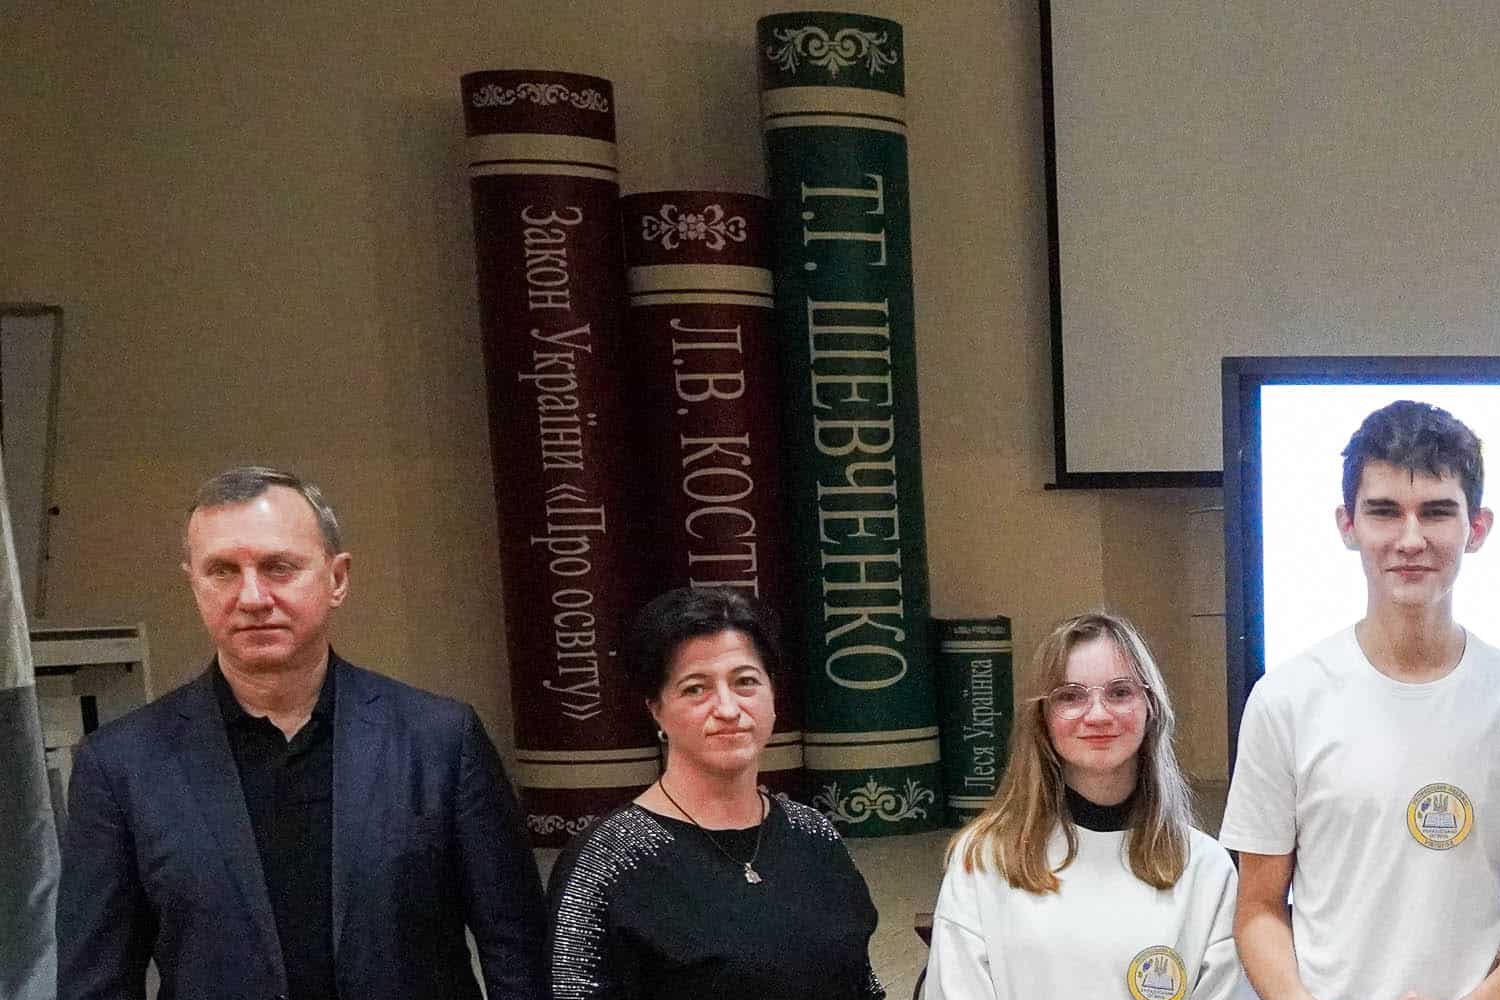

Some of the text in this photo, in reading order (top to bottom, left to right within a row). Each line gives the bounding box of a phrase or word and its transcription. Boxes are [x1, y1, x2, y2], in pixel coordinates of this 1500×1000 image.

[518, 205, 616, 721] Закон України «Про освіту»
[670, 318, 742, 416] Л.В.
[801, 173, 907, 690] Т.Г. ШЕВЧЕНКО
[960, 659, 1002, 790] Леся Українка
